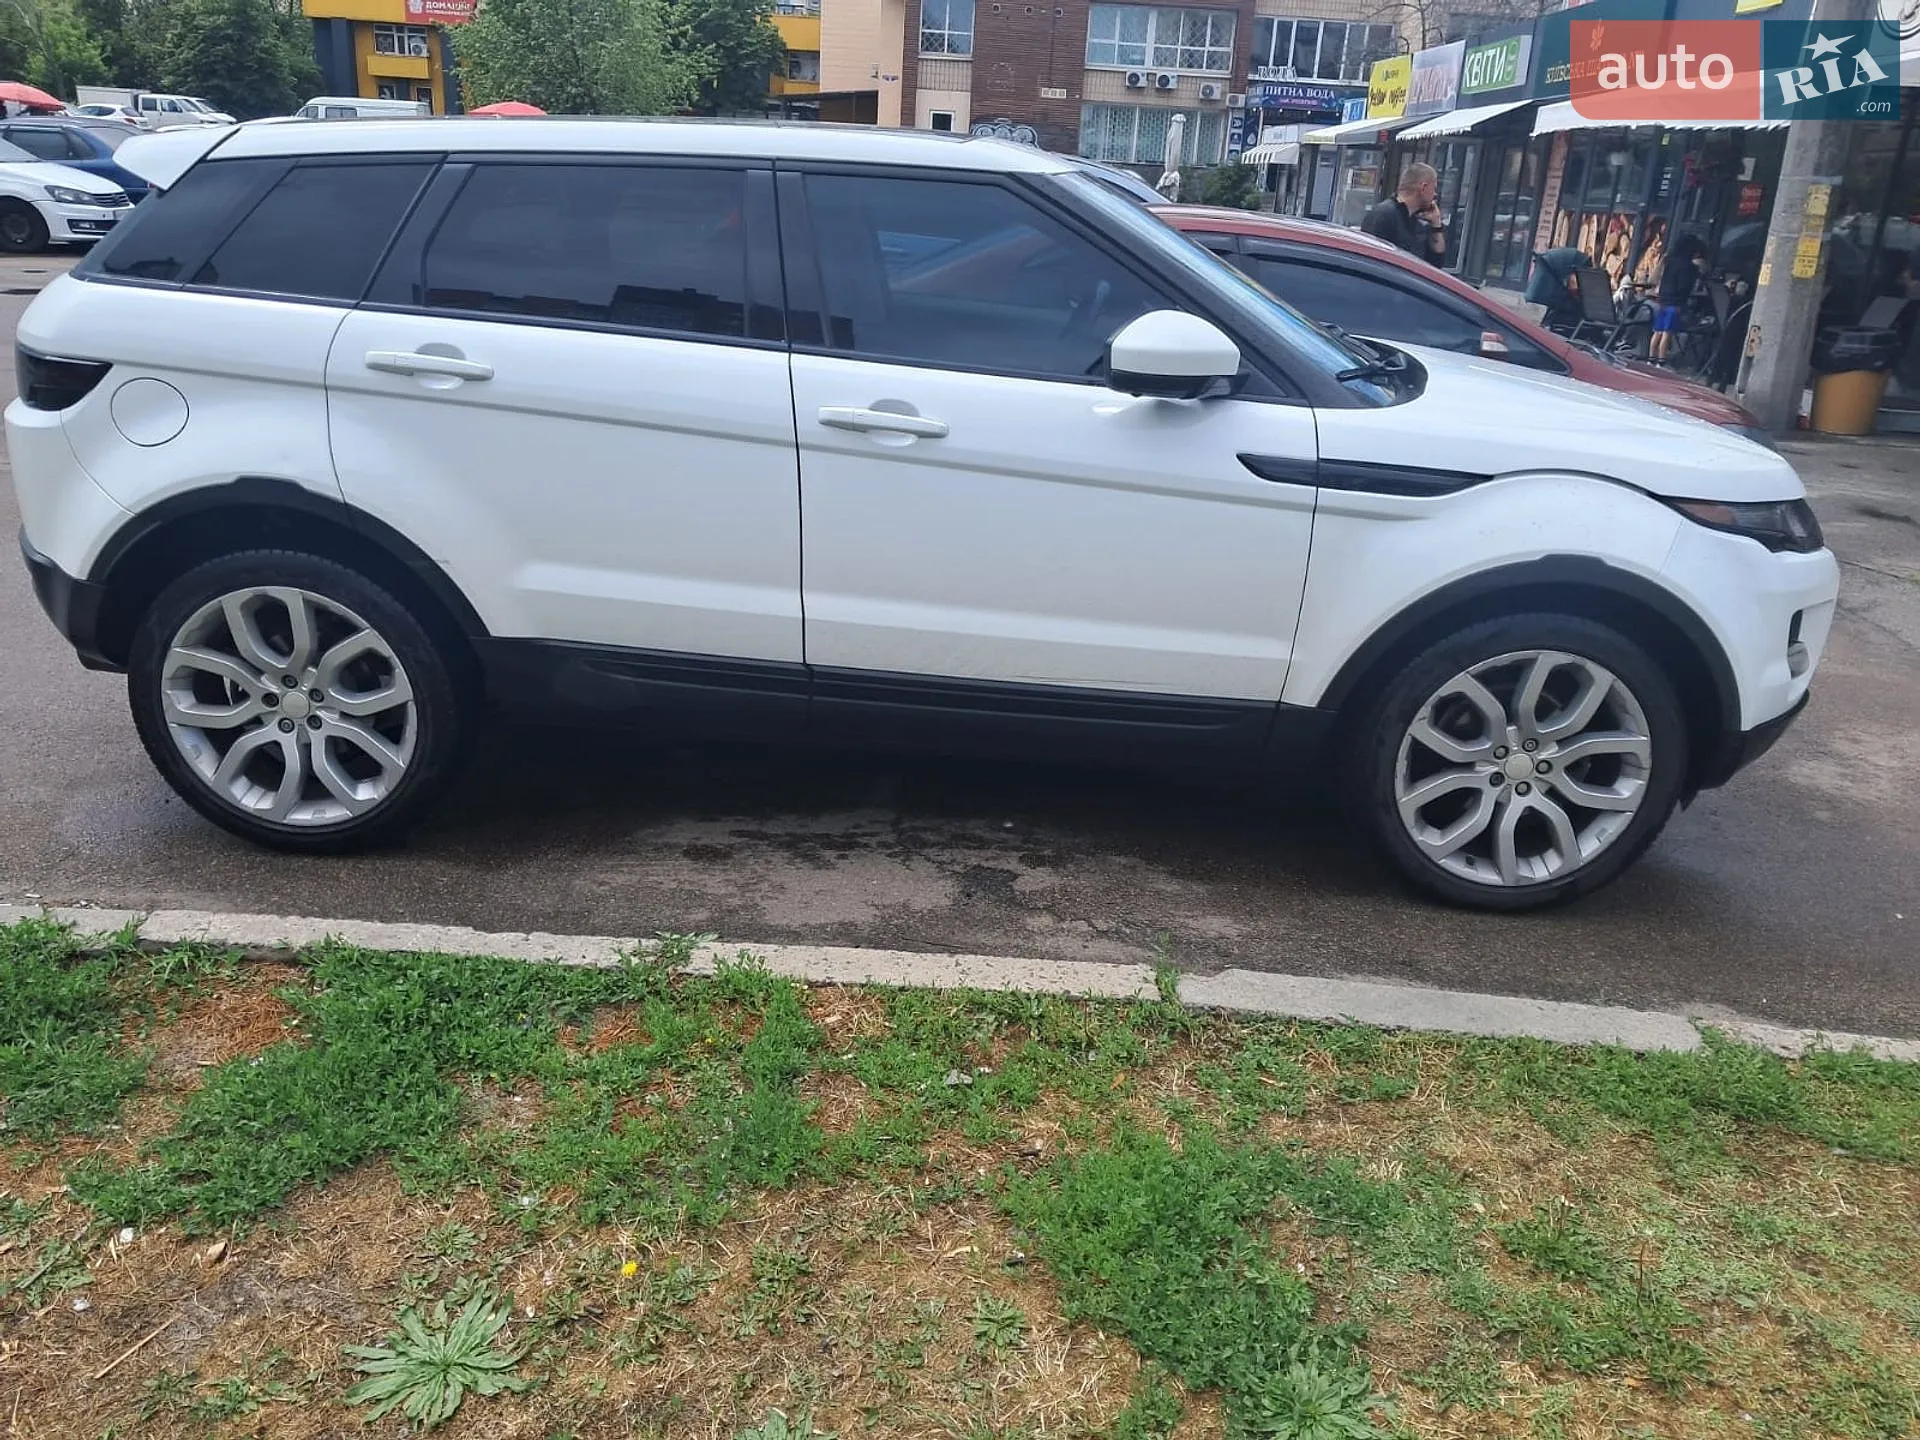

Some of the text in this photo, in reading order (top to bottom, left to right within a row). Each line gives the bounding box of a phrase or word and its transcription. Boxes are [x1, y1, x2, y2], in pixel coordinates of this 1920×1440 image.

[1463, 45, 1507, 88] КВІТИ
[1265, 85, 1336, 100] ПИТНА ВОДА
